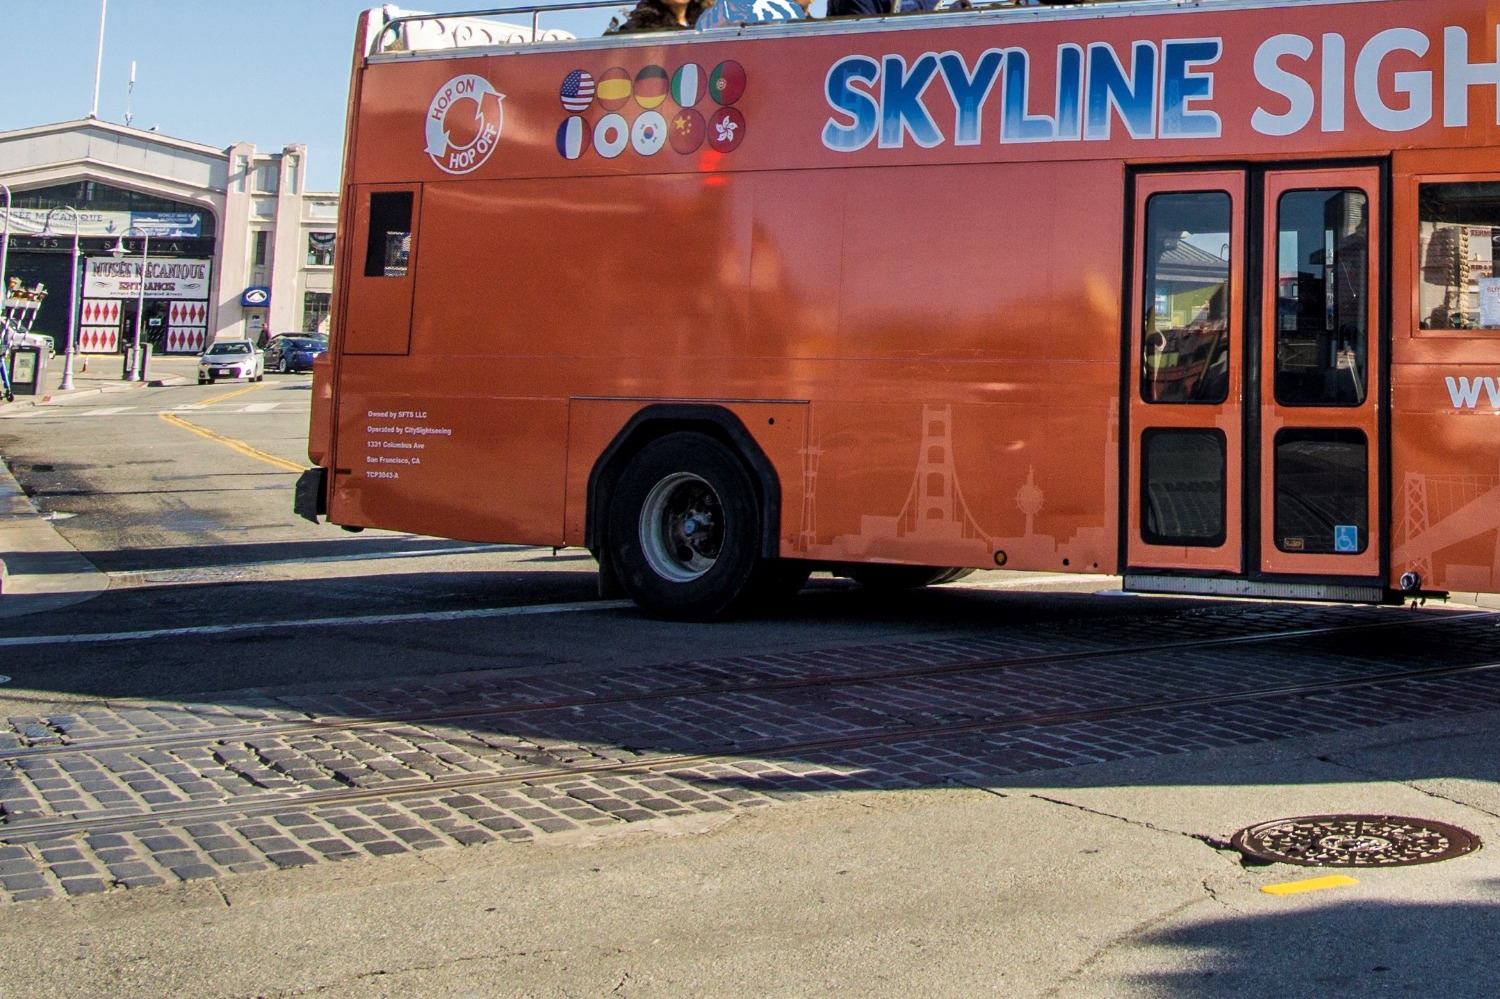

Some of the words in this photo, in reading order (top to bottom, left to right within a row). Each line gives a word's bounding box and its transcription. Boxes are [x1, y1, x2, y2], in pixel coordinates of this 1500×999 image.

[822, 36, 1223, 152] SKYLINE
[431, 88, 453, 120] HOP
[456, 79, 475, 94] ON
[449, 148, 476, 168] HOP
[476, 122, 496, 153] OFF
[40, 239, 58, 247] 45
[367, 410, 388, 418] Owned
[389, 411, 397, 419] by
[367, 426, 395, 434] Operated
[395, 426, 403, 434] by
[383, 441, 412, 449] Columbus
[380, 456, 410, 465] Francisco,
